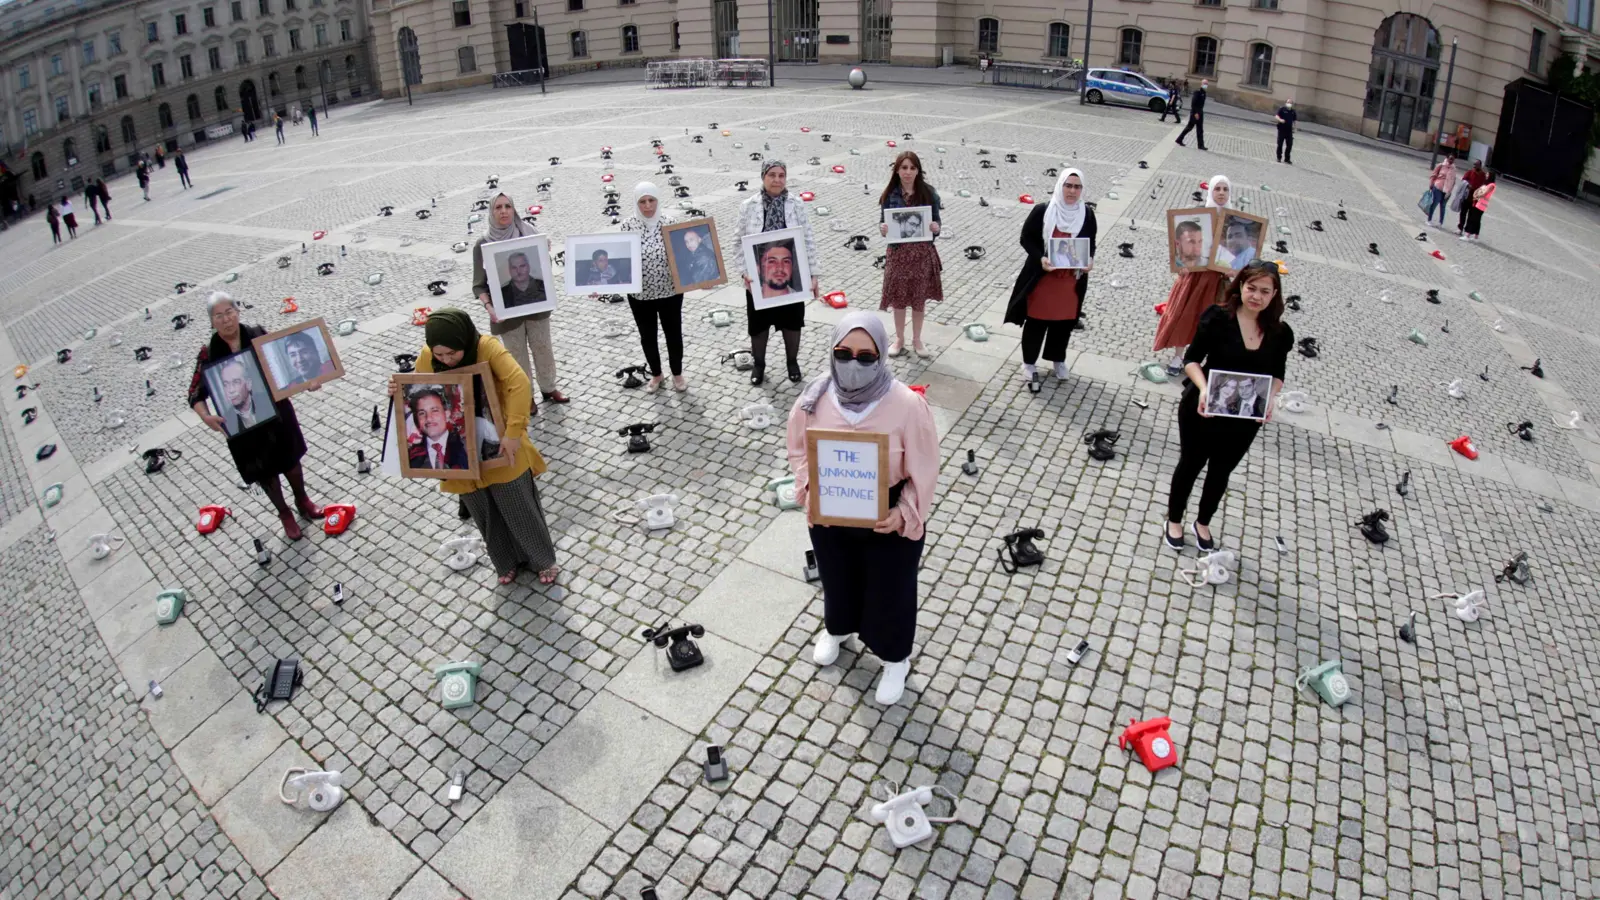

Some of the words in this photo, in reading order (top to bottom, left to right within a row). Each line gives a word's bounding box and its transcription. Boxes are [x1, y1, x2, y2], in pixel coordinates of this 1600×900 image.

[833, 449, 860, 463] THE
[818, 467, 876, 480] UNKNOWN
[818, 485, 874, 500] DETAINEE
